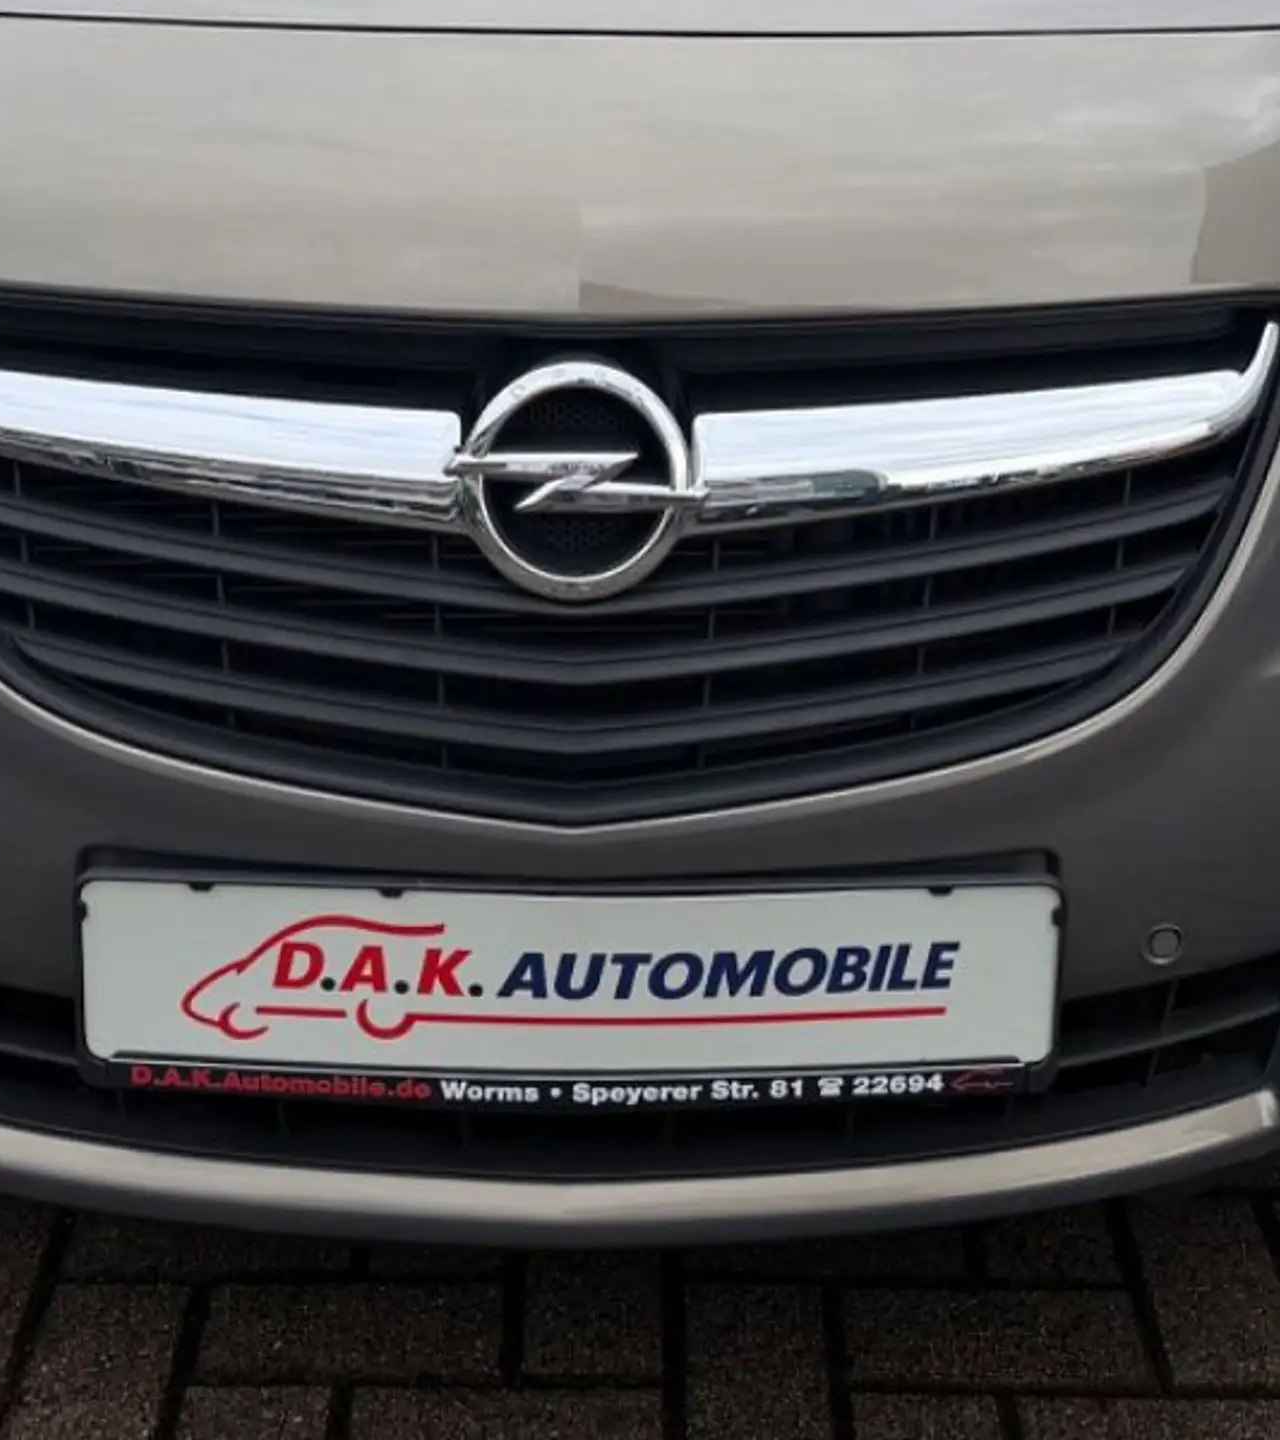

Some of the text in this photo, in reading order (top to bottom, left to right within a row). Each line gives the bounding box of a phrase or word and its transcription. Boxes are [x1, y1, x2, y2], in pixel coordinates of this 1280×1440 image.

[272, 941, 961, 1000] D.A.K. AUTOMOBILE
[130, 1065, 944, 1105] D.A.K.Automobile.de Worms Speyerer Str. 81 22694
